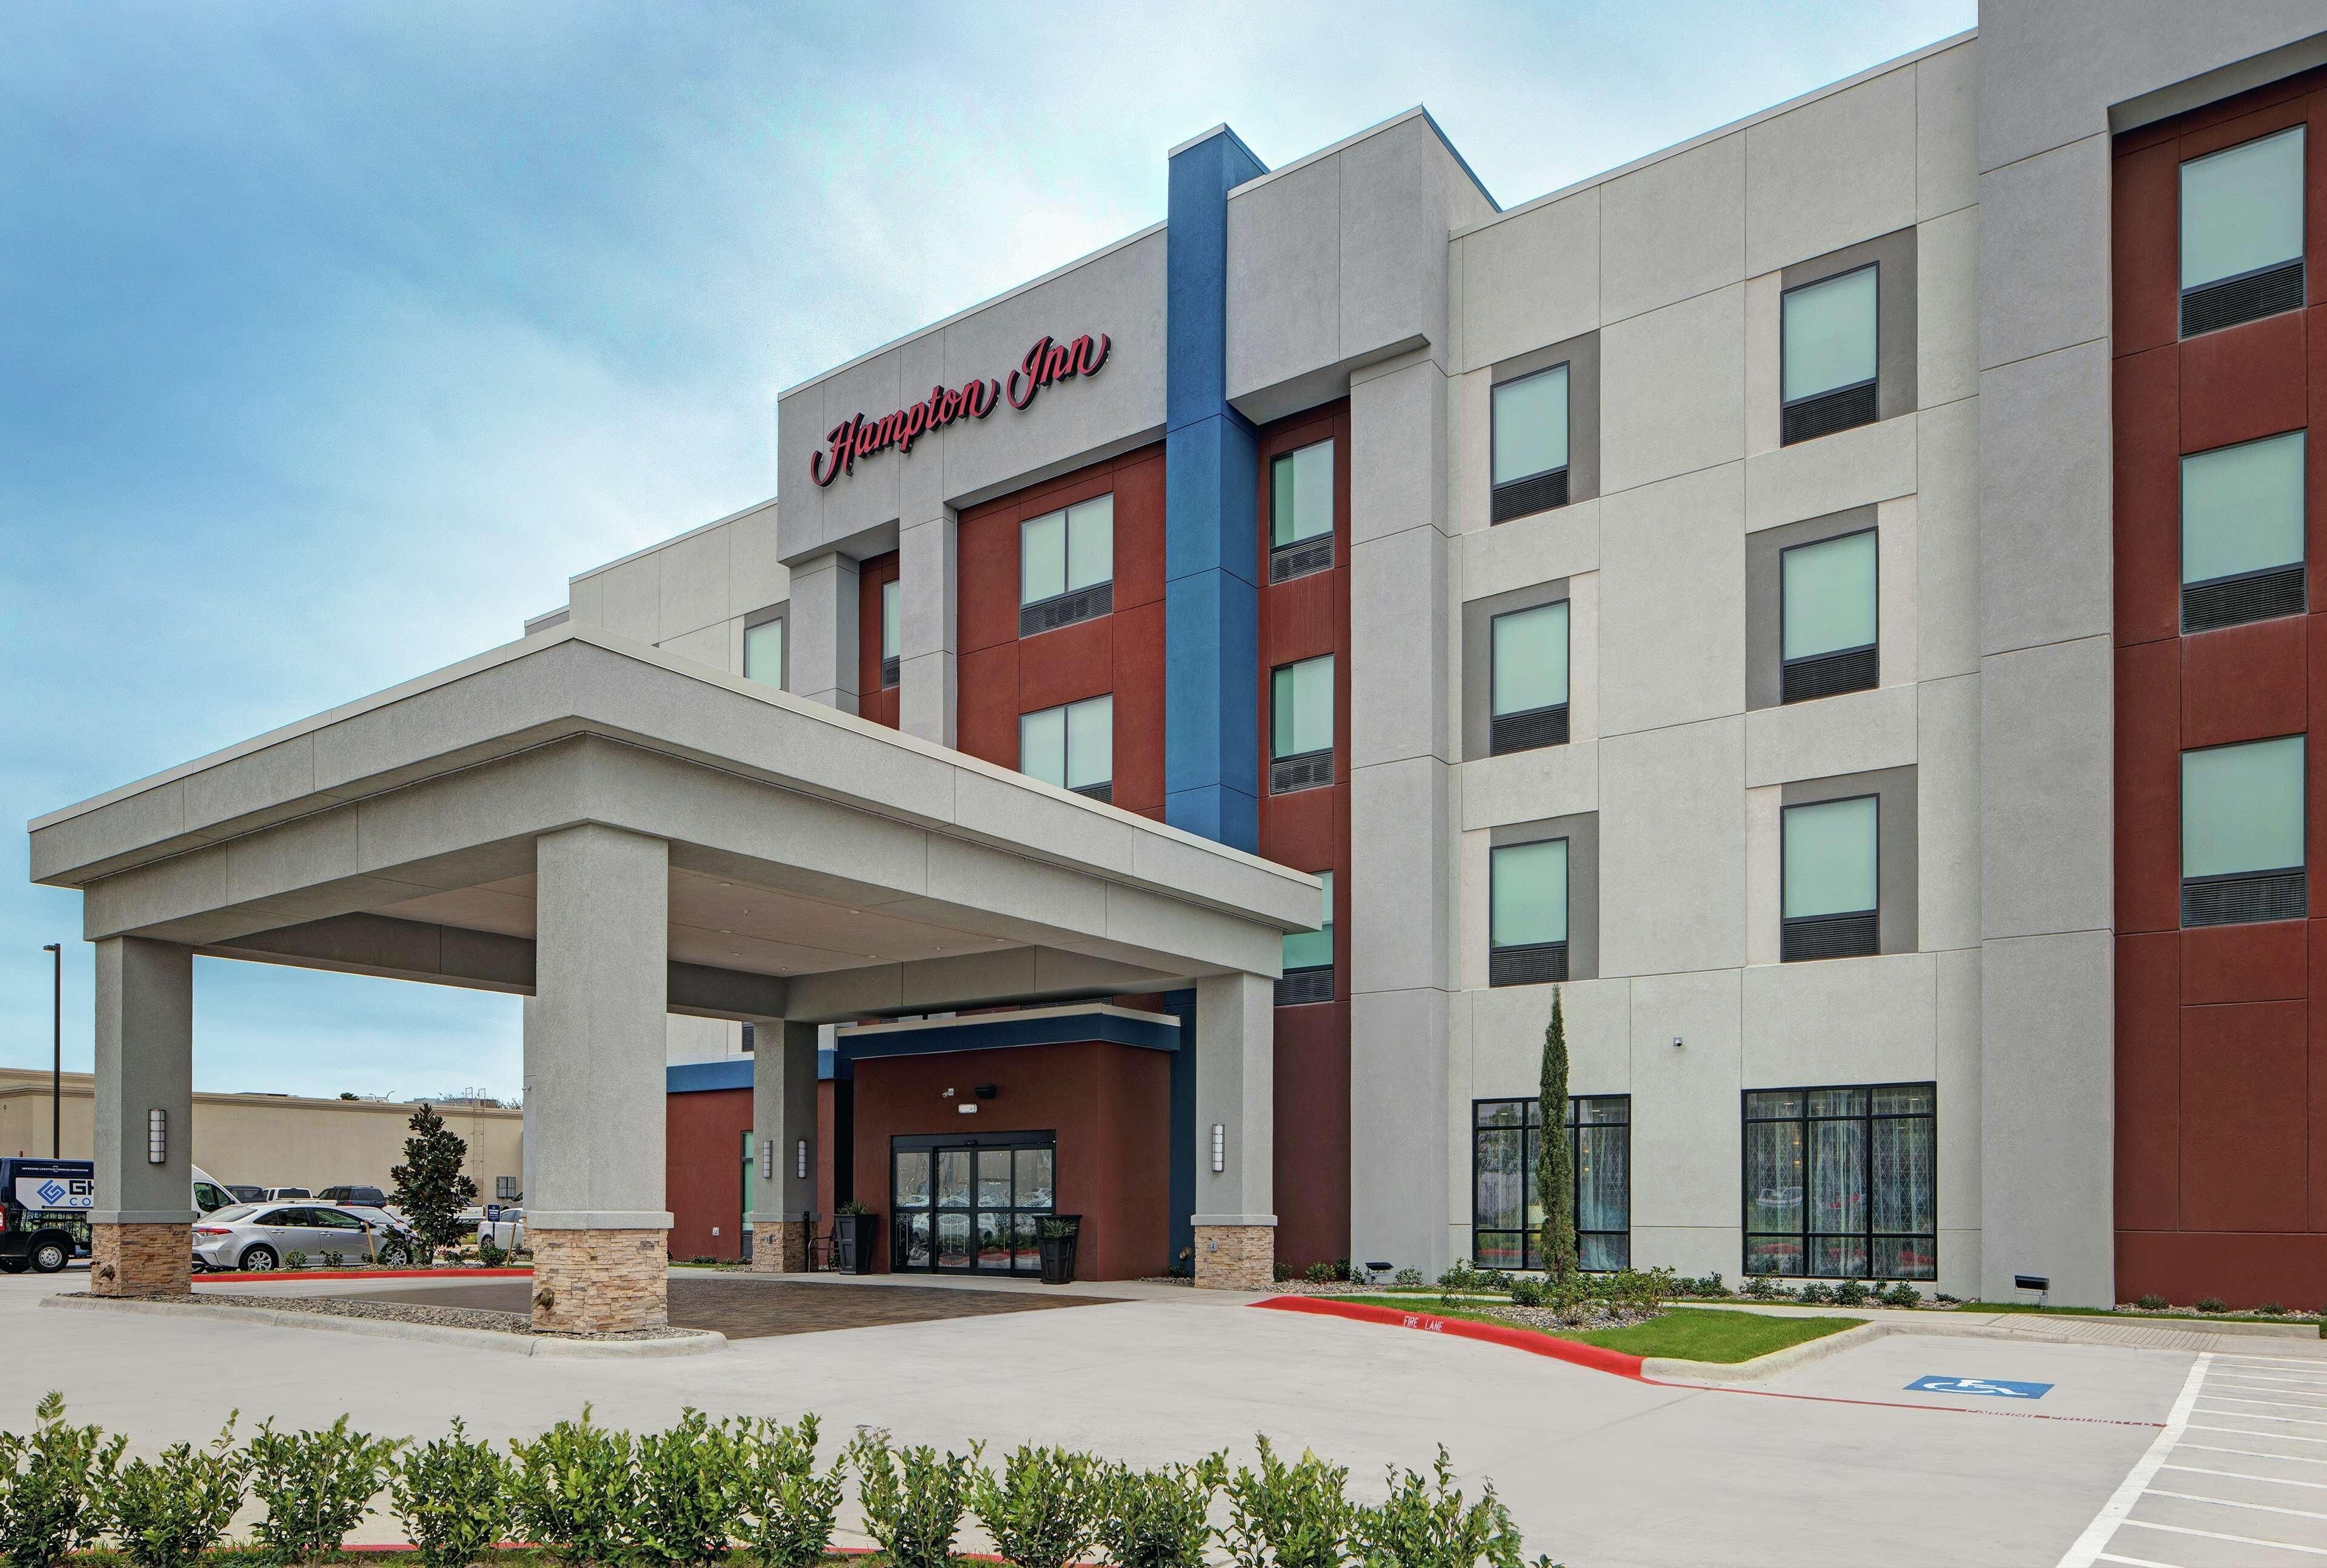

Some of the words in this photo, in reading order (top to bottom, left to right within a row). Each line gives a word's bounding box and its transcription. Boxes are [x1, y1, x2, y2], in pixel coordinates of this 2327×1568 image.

[810, 378, 1001, 487] Hampton
[1006, 333, 1112, 411] Inn
[1403, 1315, 1419, 1328] FIRE
[1424, 1319, 1443, 1332] LANE
